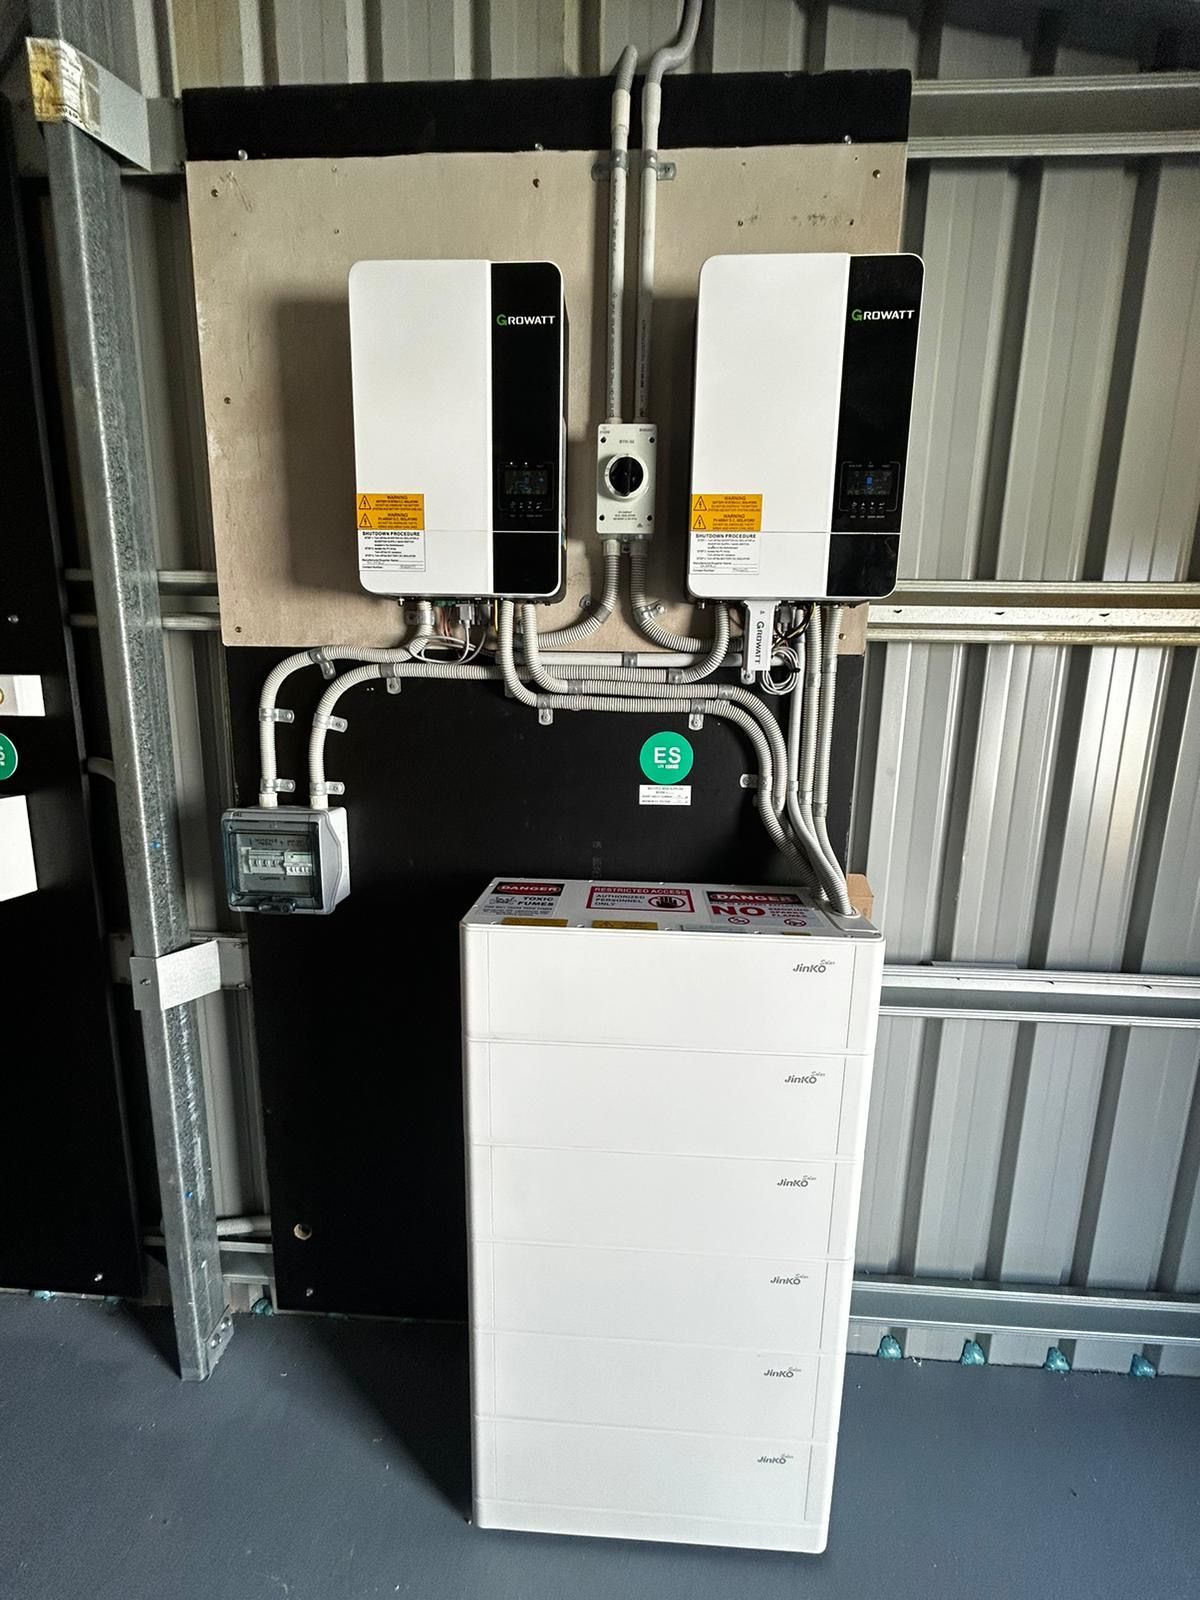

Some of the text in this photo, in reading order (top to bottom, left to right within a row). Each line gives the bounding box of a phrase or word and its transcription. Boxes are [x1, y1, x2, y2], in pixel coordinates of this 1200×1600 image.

[496, 314, 556, 326] GROWATT
[851, 309, 915, 322] GROWATT
[754, 621, 765, 664] GROWATT
[654, 747, 682, 764] ES
[717, 894, 788, 902] DANGER
[711, 905, 766, 916] NO
